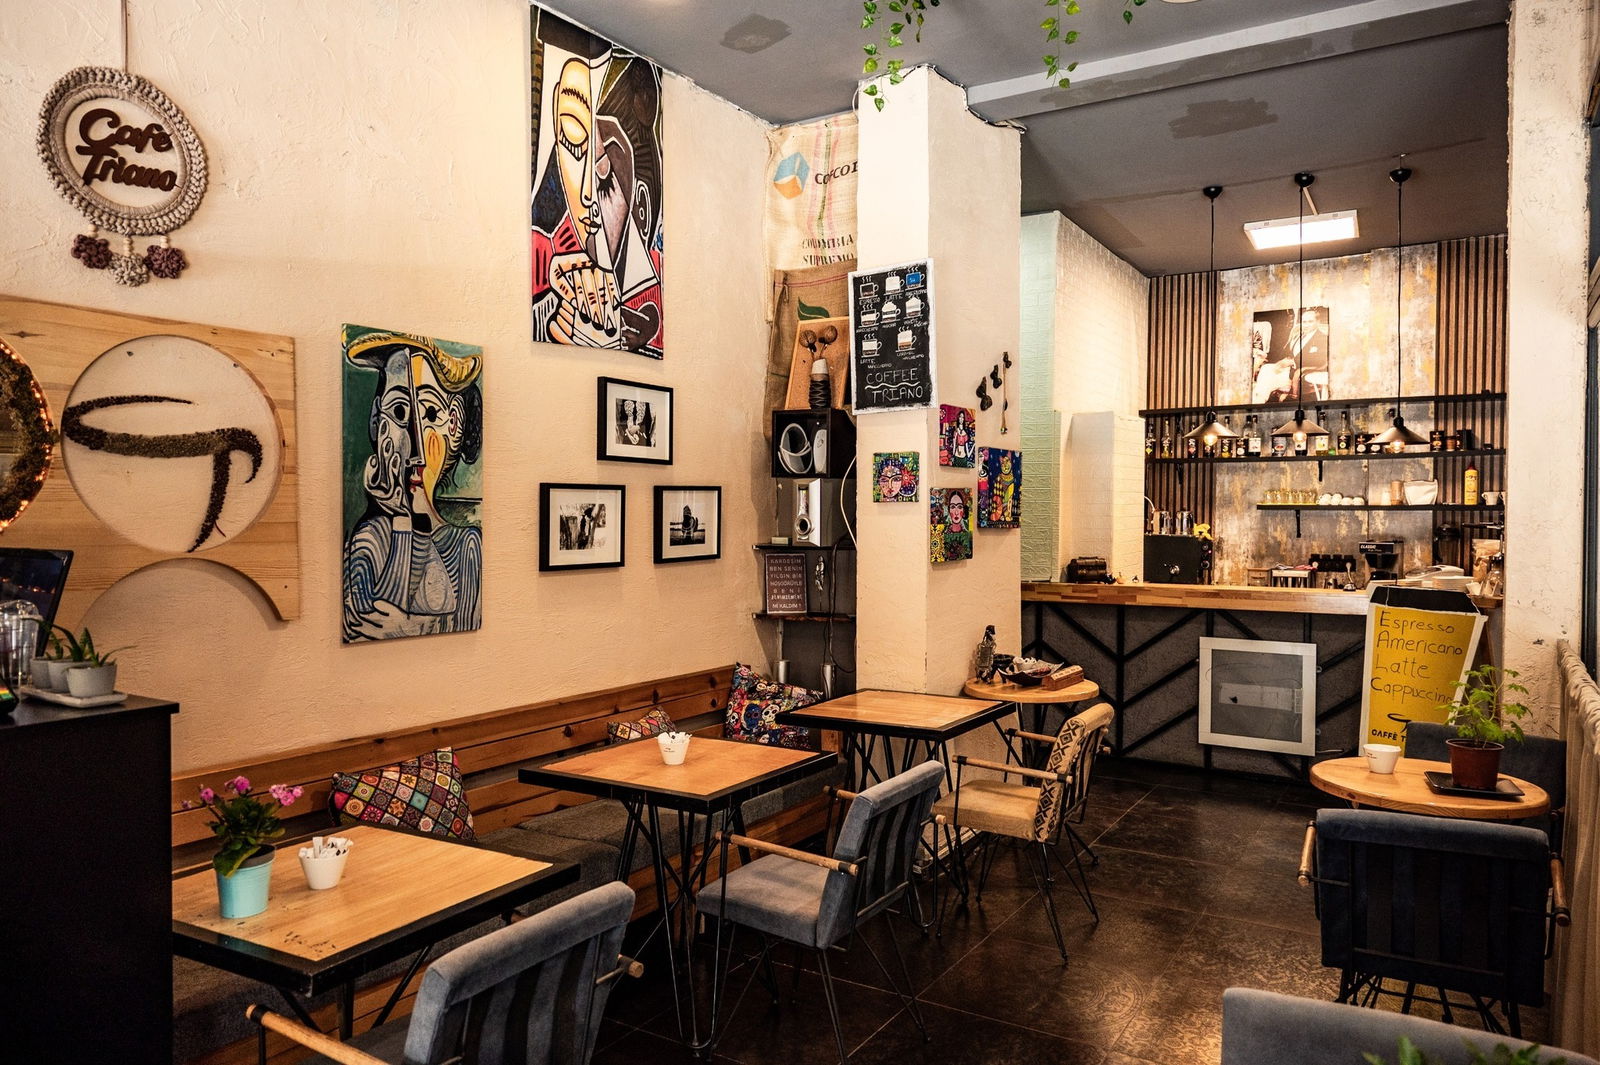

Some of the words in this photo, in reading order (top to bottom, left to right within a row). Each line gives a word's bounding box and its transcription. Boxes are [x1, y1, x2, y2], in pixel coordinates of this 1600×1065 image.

[75, 145, 177, 191] Triano
[866, 368, 919, 385] COFFEE
[872, 386, 923, 403] TRIANO
[1379, 610, 1455, 635] Espresso
[1376, 630, 1463, 656] Americano
[1375, 653, 1431, 679] Latte
